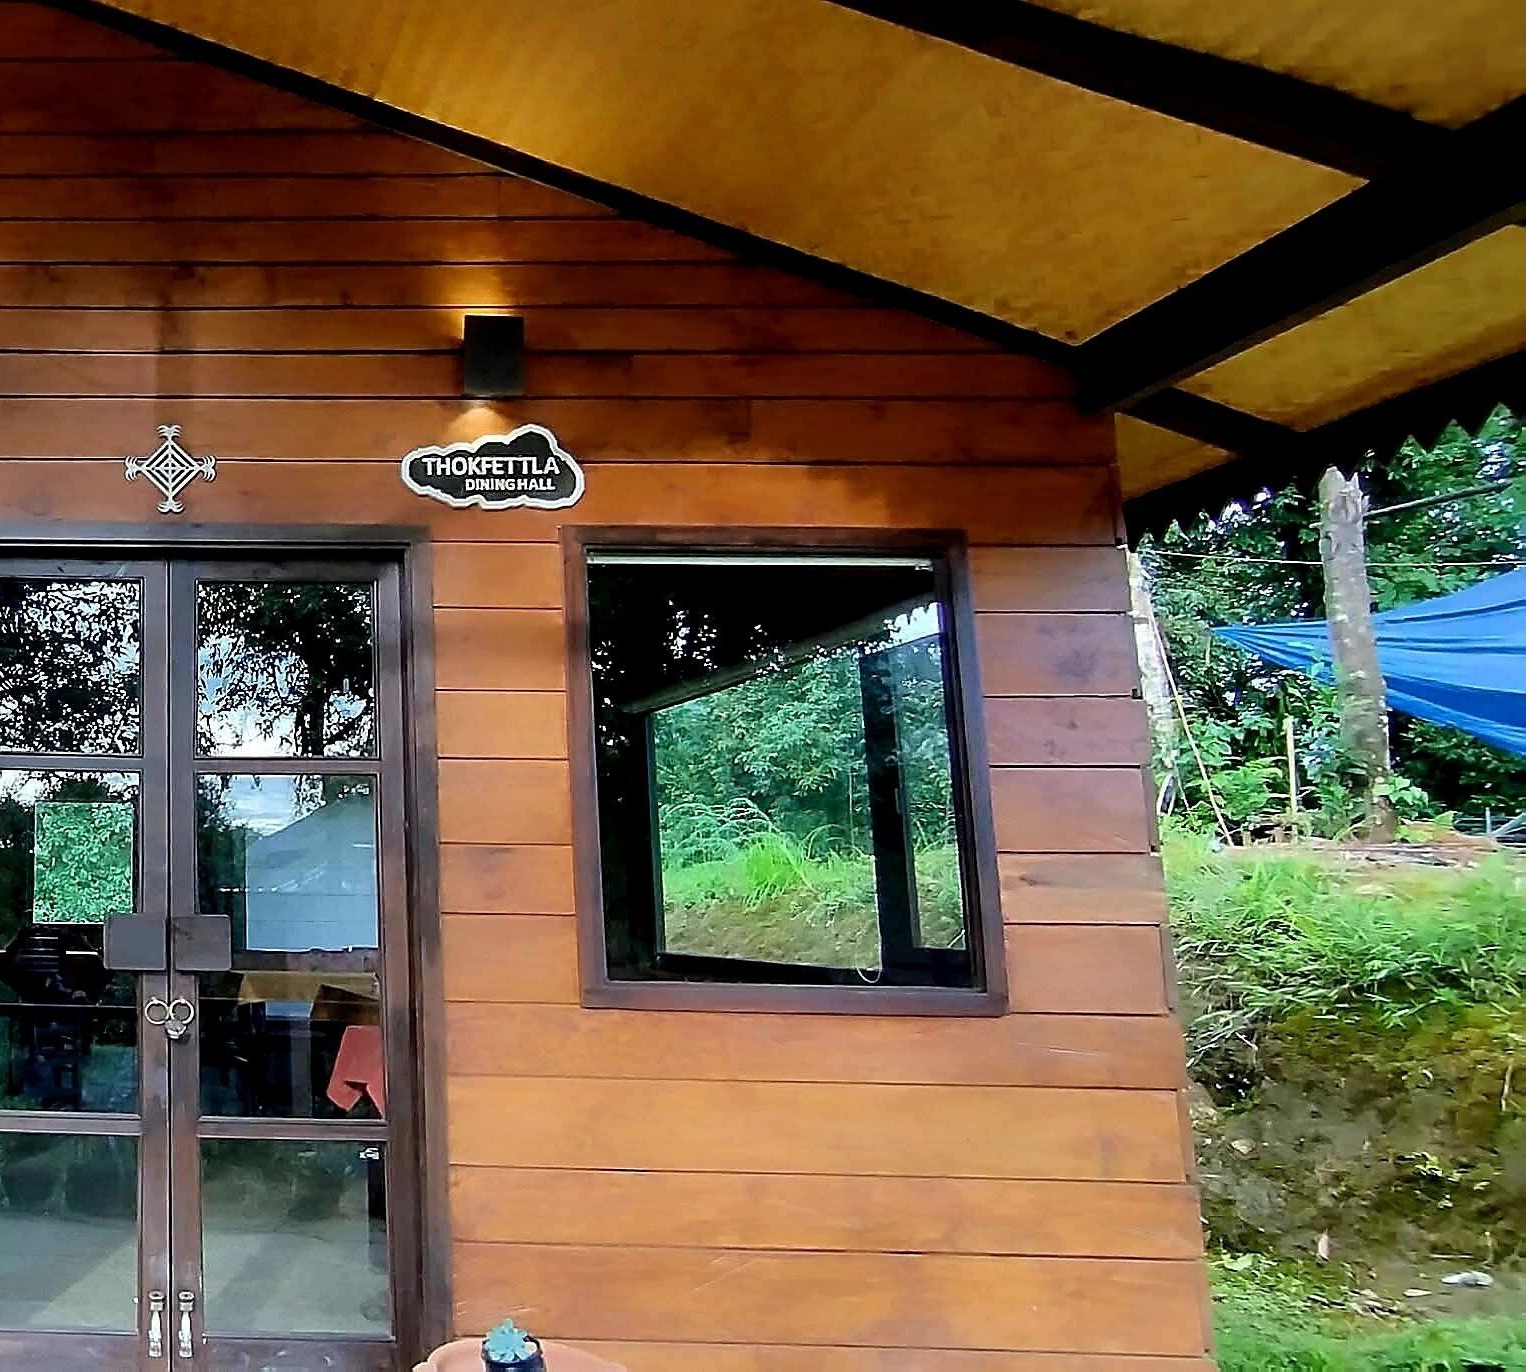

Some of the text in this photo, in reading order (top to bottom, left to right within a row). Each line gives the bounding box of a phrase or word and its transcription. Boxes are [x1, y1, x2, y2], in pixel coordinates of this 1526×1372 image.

[422, 457, 560, 476] THOKFETTLA
[465, 479, 556, 491] DINING HALL
